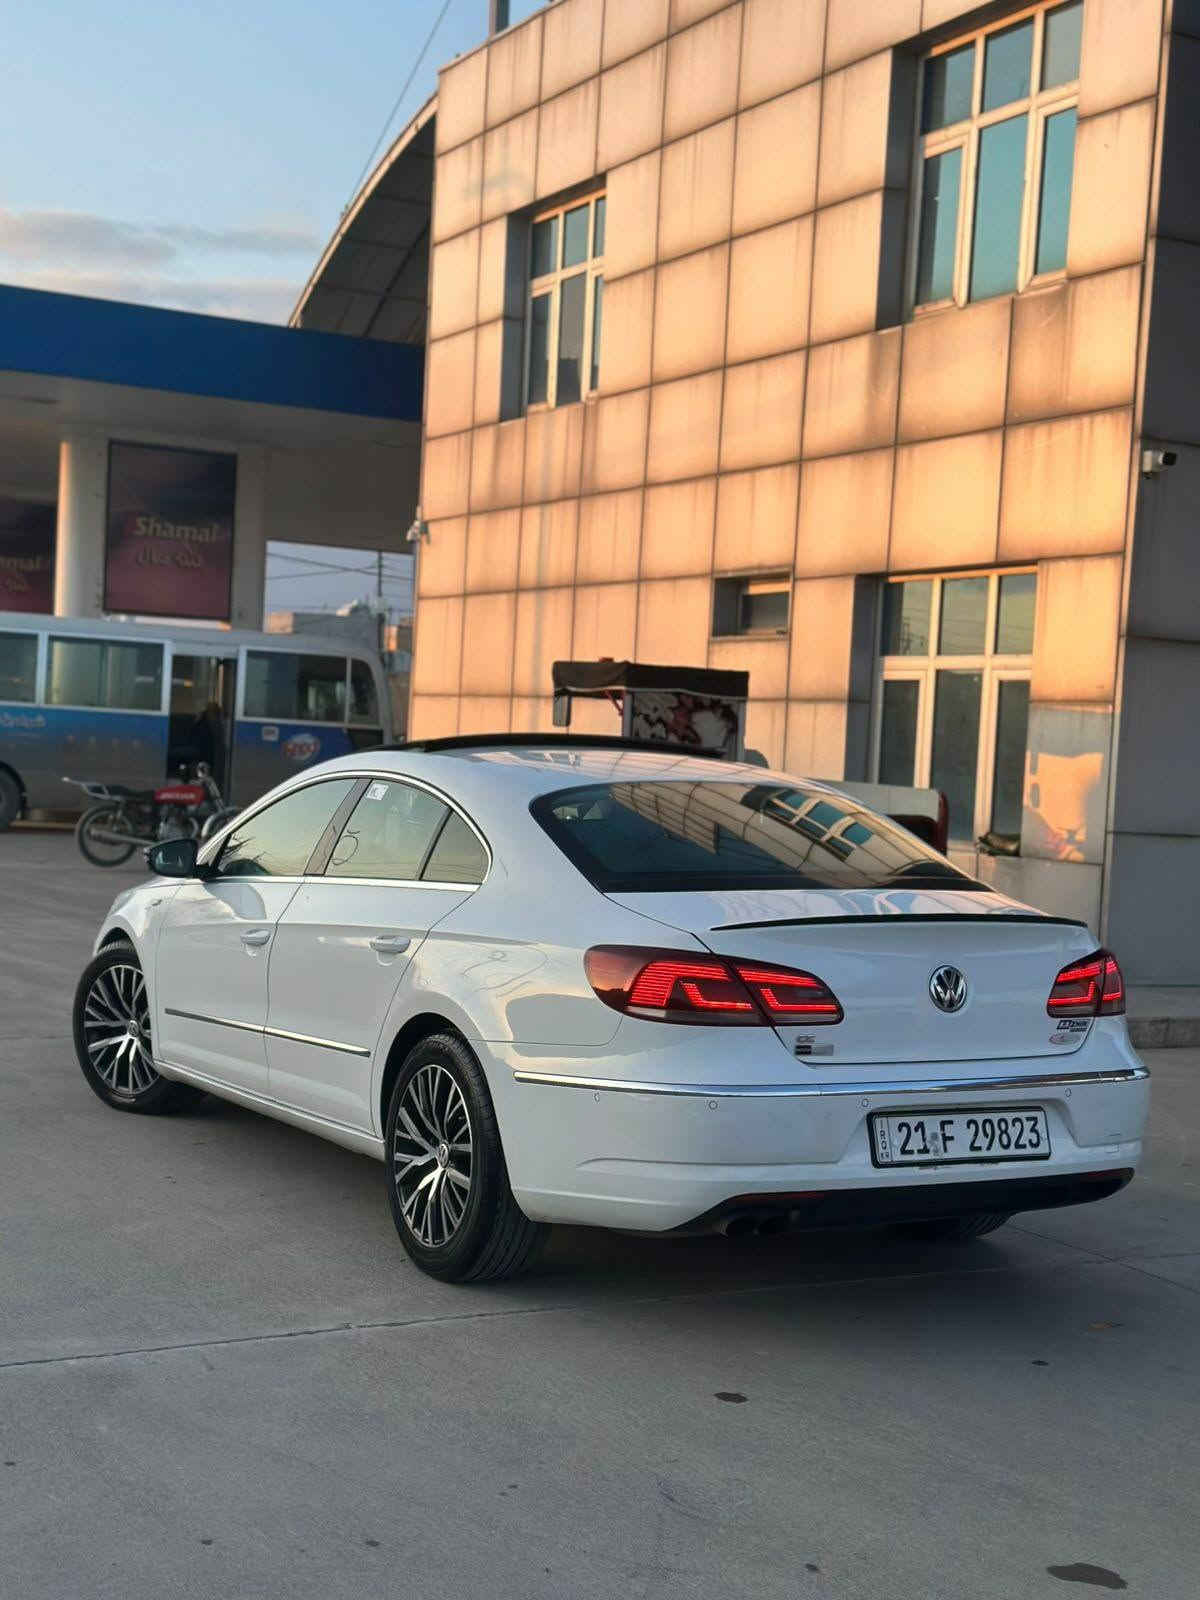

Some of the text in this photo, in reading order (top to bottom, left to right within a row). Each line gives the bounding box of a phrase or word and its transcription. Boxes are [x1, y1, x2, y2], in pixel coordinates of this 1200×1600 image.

[134, 515, 217, 544] Shamal
[897, 1116, 1041, 1155] 21 F 29823
